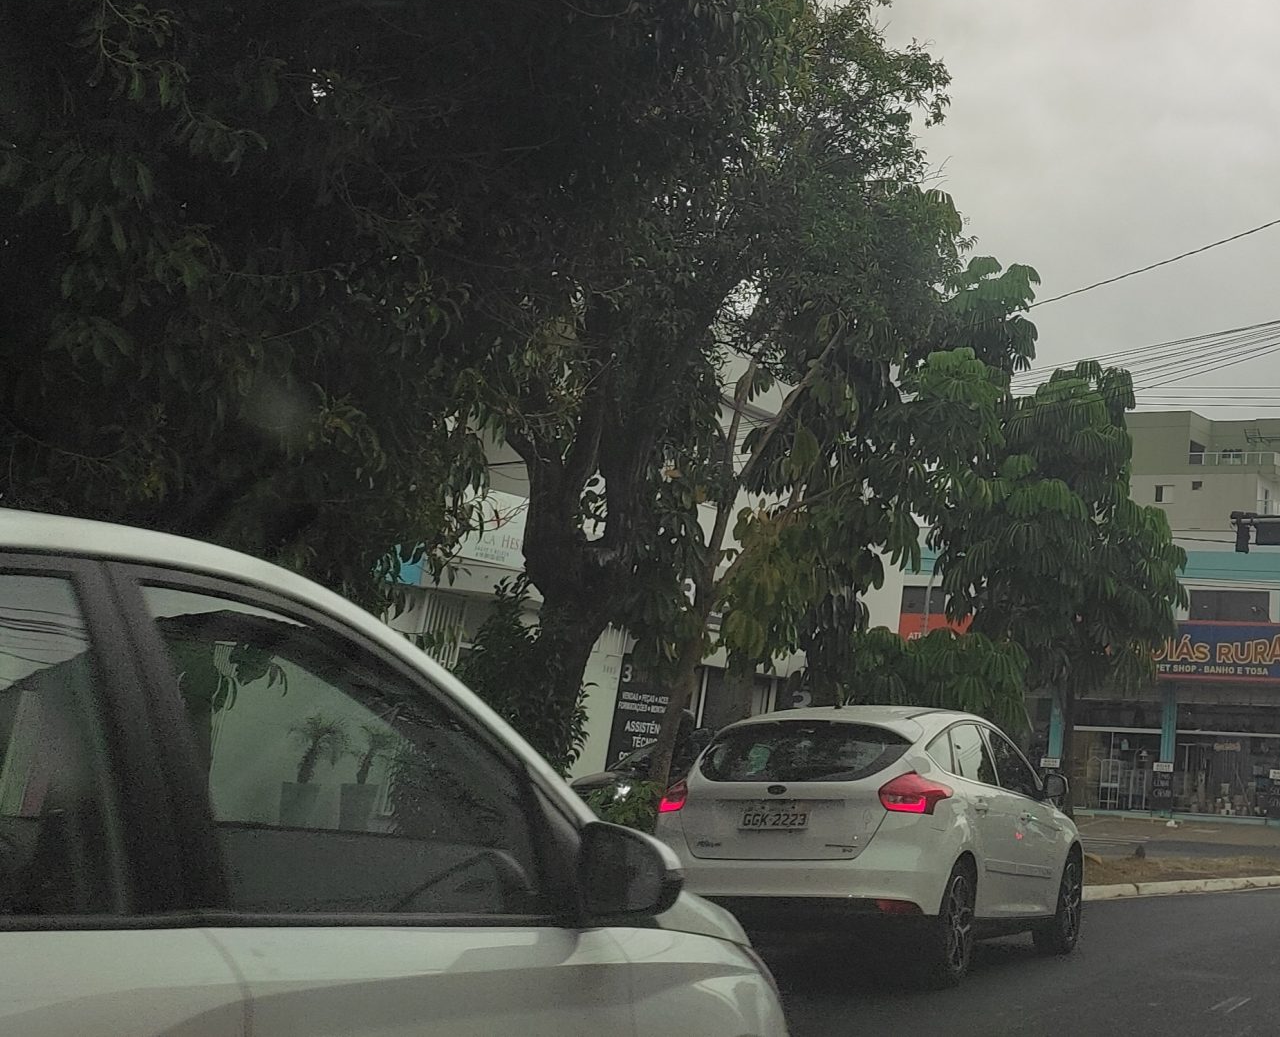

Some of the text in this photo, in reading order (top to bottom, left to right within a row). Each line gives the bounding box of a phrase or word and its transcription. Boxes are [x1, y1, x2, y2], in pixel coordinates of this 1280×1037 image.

[1172, 664, 1197, 673] SHOP
[1203, 665, 1235, 675] BANHO
[1237, 666, 1244, 675] E
[1244, 666, 1269, 676] TOSA
[771, 814, 808, 827] 2223
